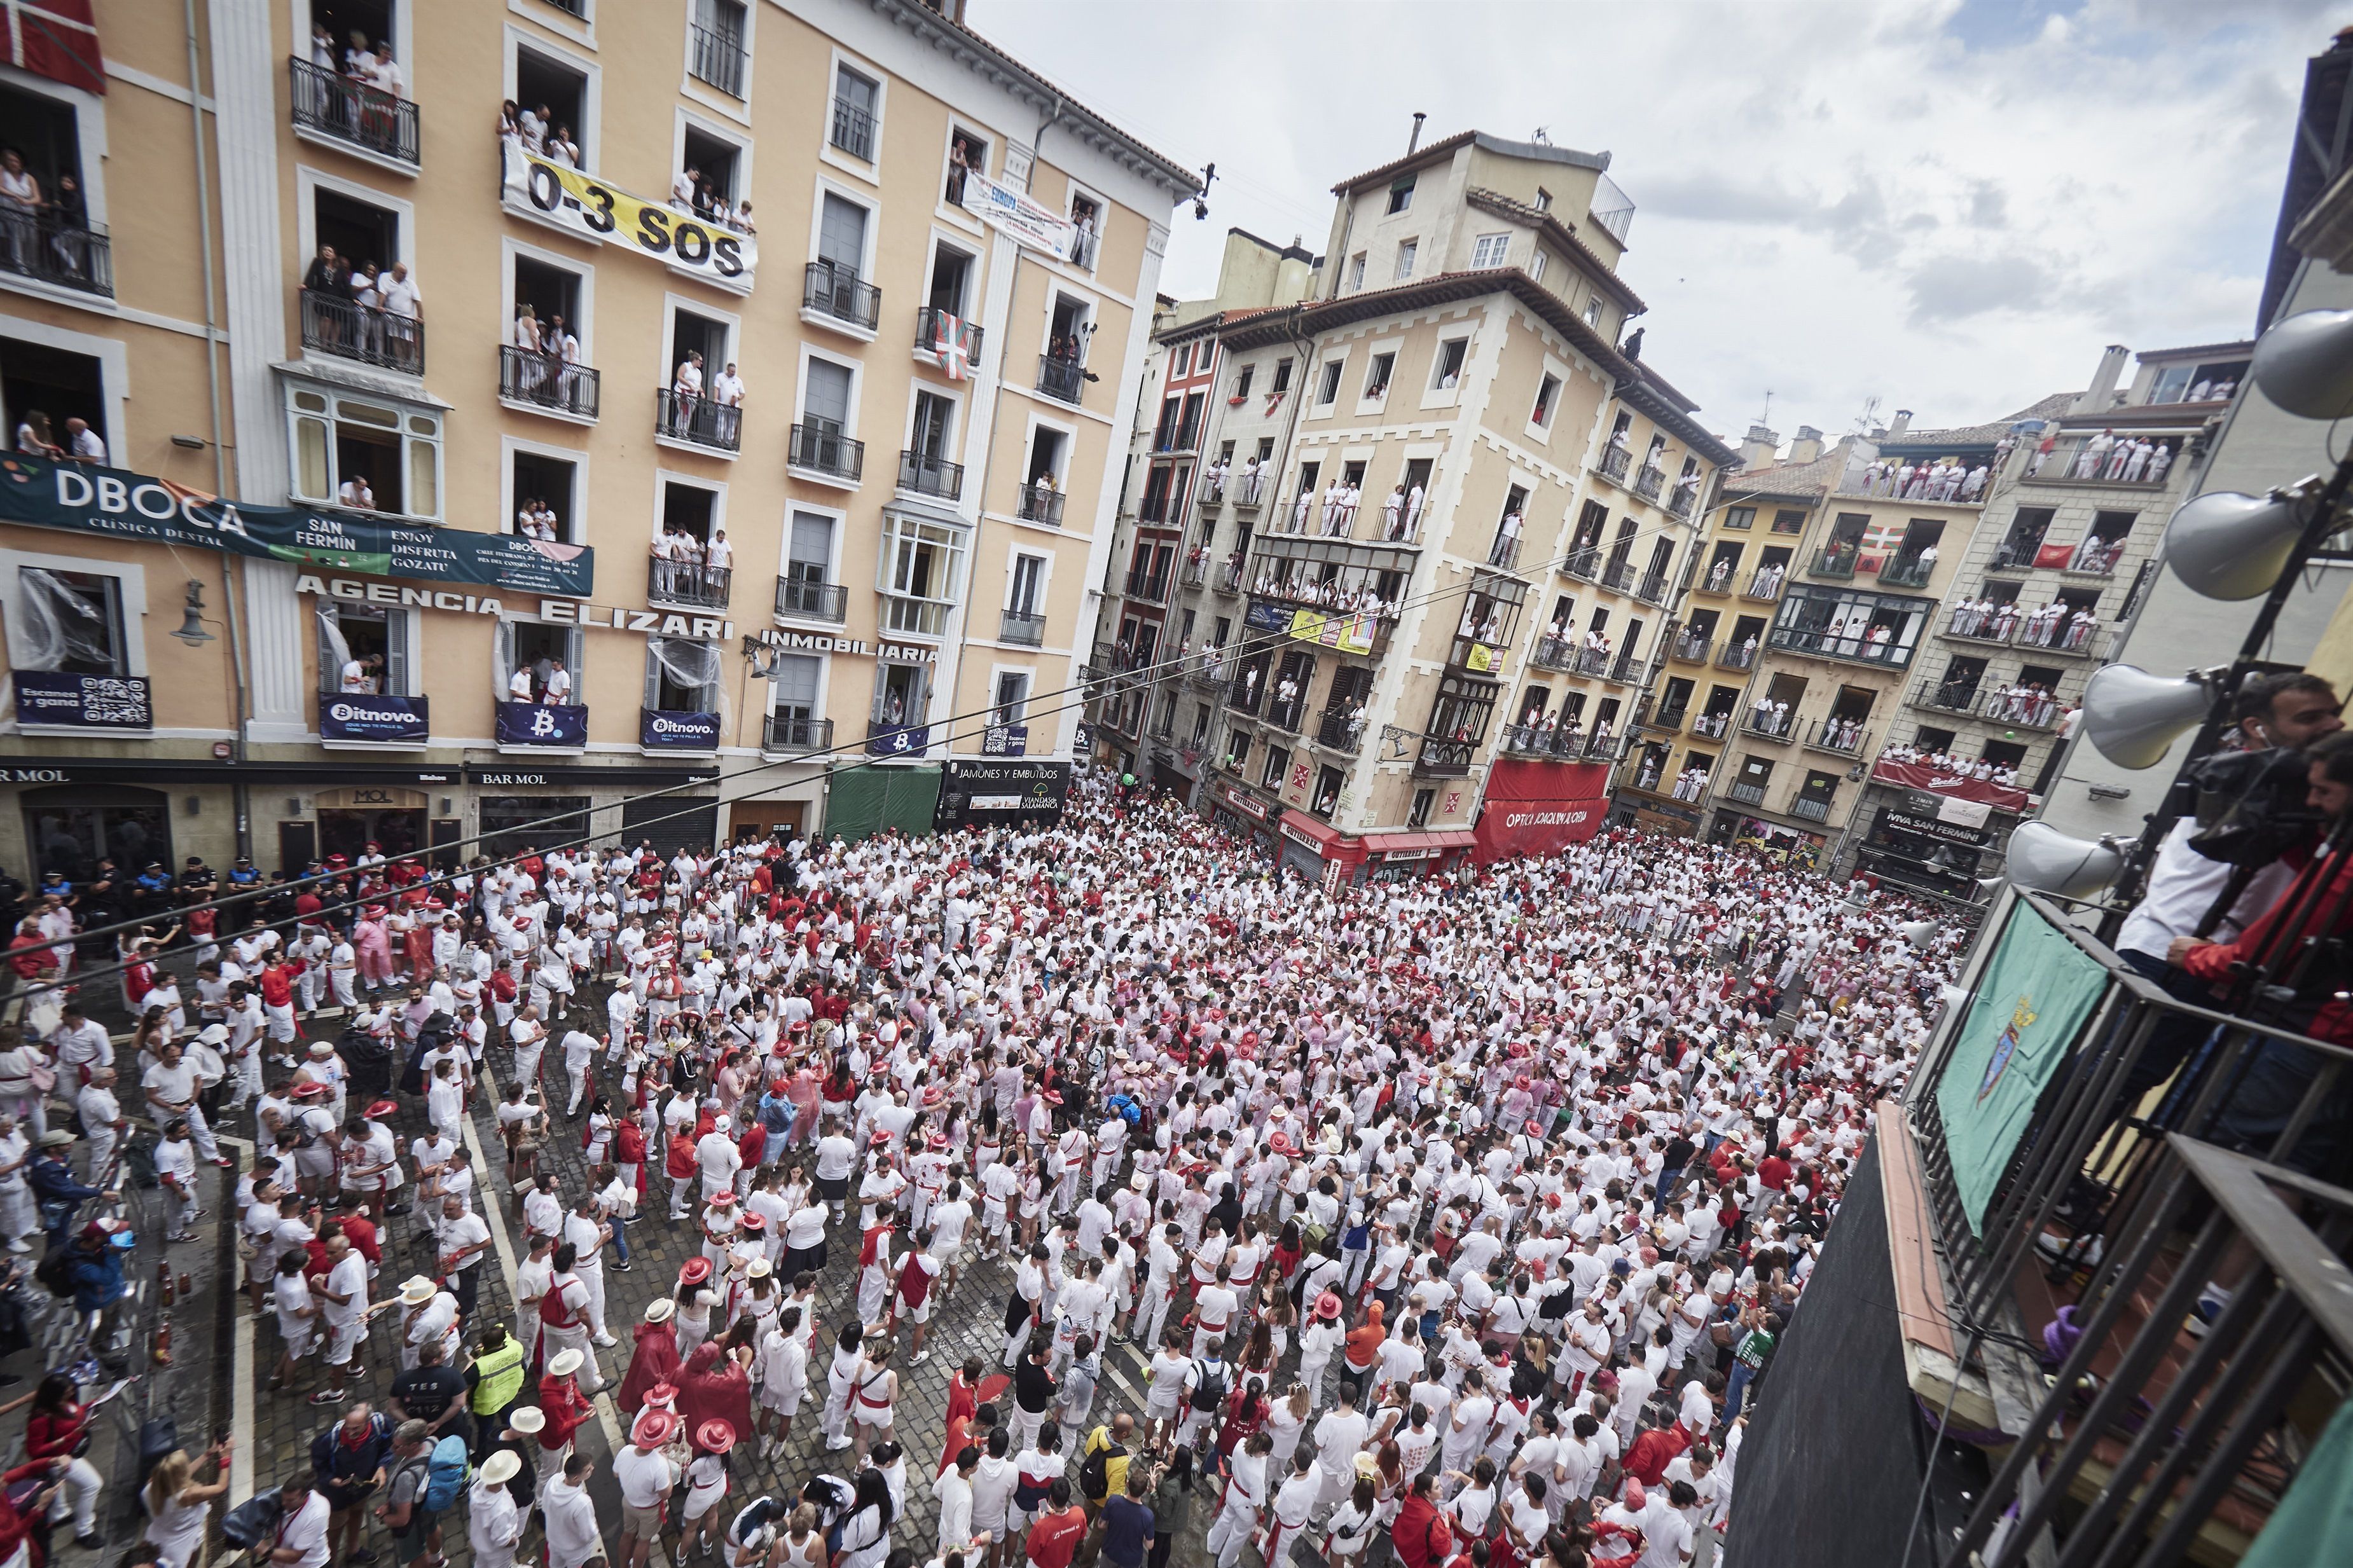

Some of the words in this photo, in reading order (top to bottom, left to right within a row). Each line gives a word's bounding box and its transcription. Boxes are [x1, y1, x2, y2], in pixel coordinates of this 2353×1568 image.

[637, 207, 743, 278] SOS
[55, 469, 249, 537] DBOCA
[308, 518, 343, 535] SAN
[165, 528, 224, 547] DENTAL
[295, 530, 356, 551] FERMÍN
[391, 530, 434, 544] ENJOY
[391, 544, 457, 560] DISFRUTA
[392, 557, 448, 572] GOZATU
[295, 574, 504, 616] AGENCIA
[539, 599, 735, 640] ELIZARI
[761, 629, 942, 663] INMOBILIARIA
[22, 688, 79, 698] Escanea
[36, 698, 79, 708] gana
[16, 769, 71, 782] MOL
[482, 774, 513, 784] BAR
[515, 774, 547, 785] MOL
[958, 769, 1000, 779] JAMONES
[1004, 769, 1011, 778] Y
[1012, 769, 1058, 779] EMBUTIDOS
[355, 789, 392, 802] MOL
[1233, 793, 1260, 814] GUTIERREZ
[1506, 813, 1534, 827] OPTICA
[1287, 825, 1318, 849] GUTIERREZ
[1914, 820, 1935, 831] SAN
[1936, 825, 1979, 842] FERMÍN!
[1391, 849, 1423, 858] GUTIERREZ
